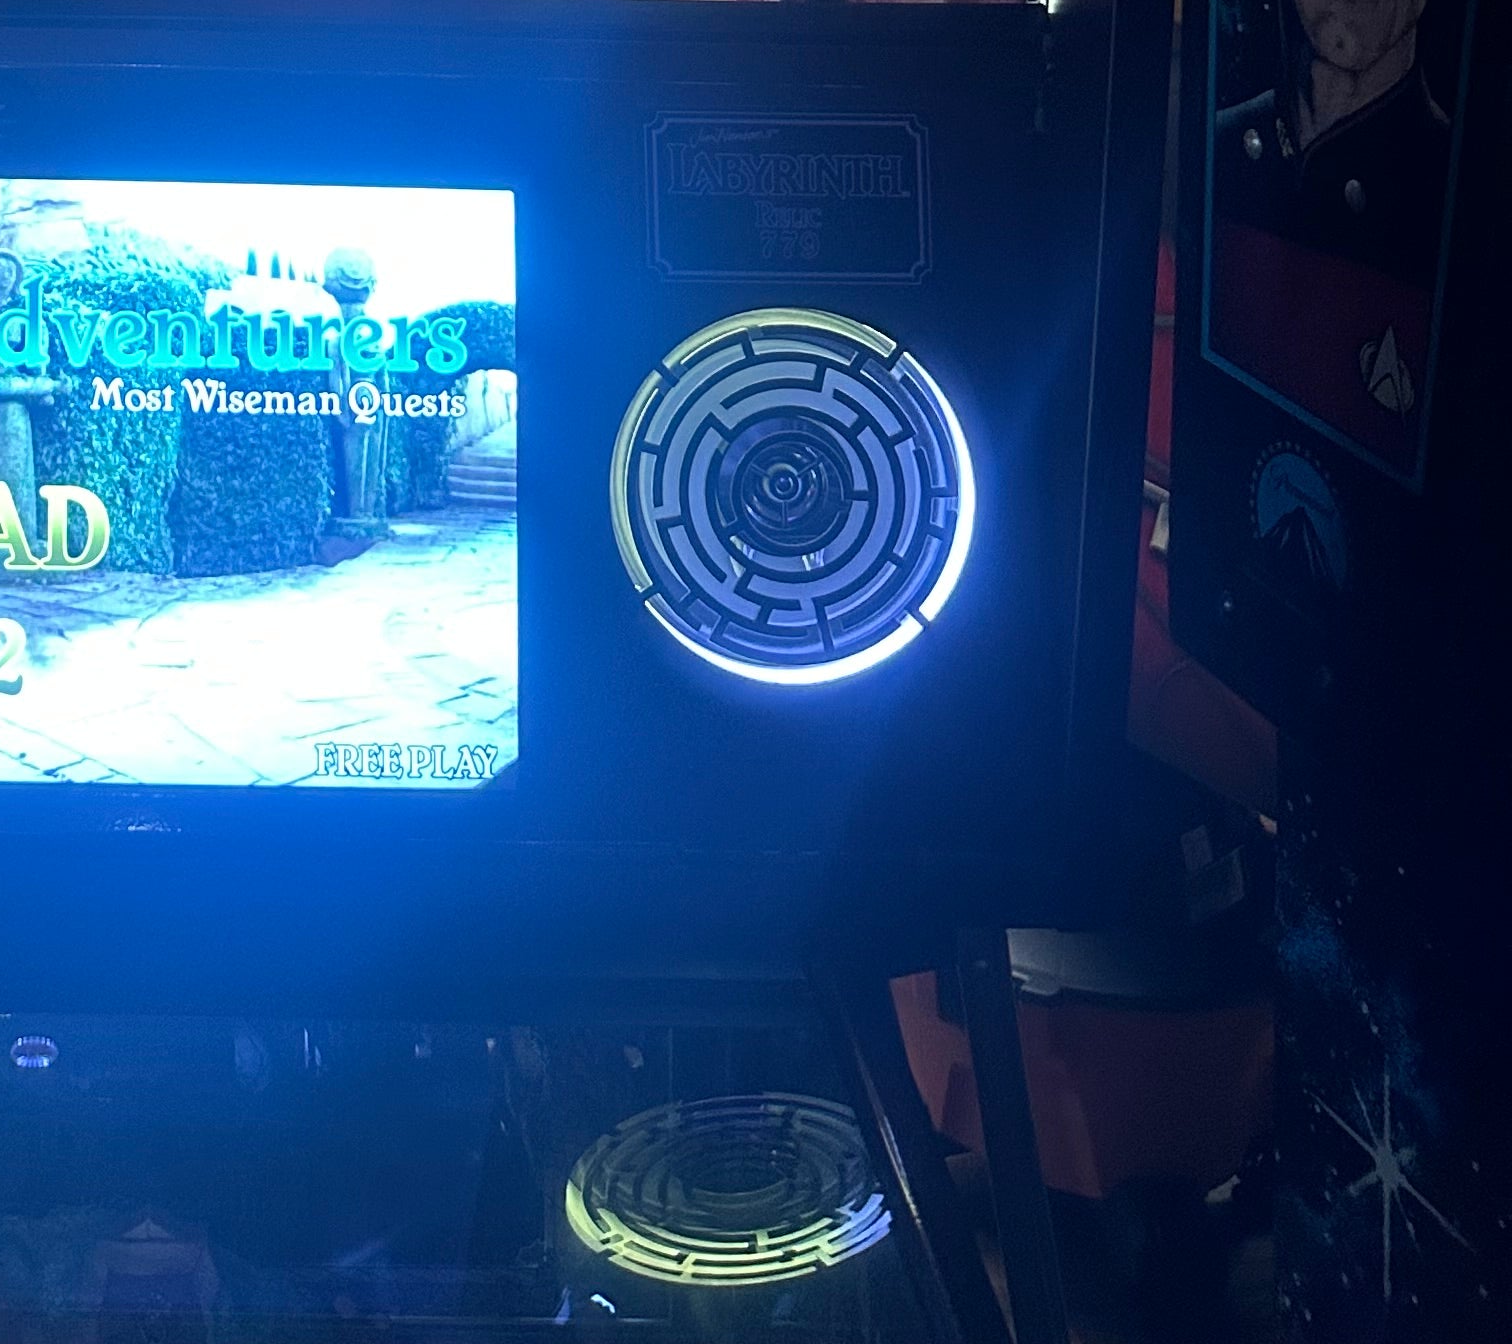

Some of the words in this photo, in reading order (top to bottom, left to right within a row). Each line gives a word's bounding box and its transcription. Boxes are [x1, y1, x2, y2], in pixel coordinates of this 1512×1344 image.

[664, 142, 911, 200] LABYRINTH
[90, 376, 175, 414] Most
[181, 379, 342, 416] Wiseman
[348, 381, 467, 424] Quests
[314, 742, 403, 779] FREE
[407, 745, 498, 780] PLAY
